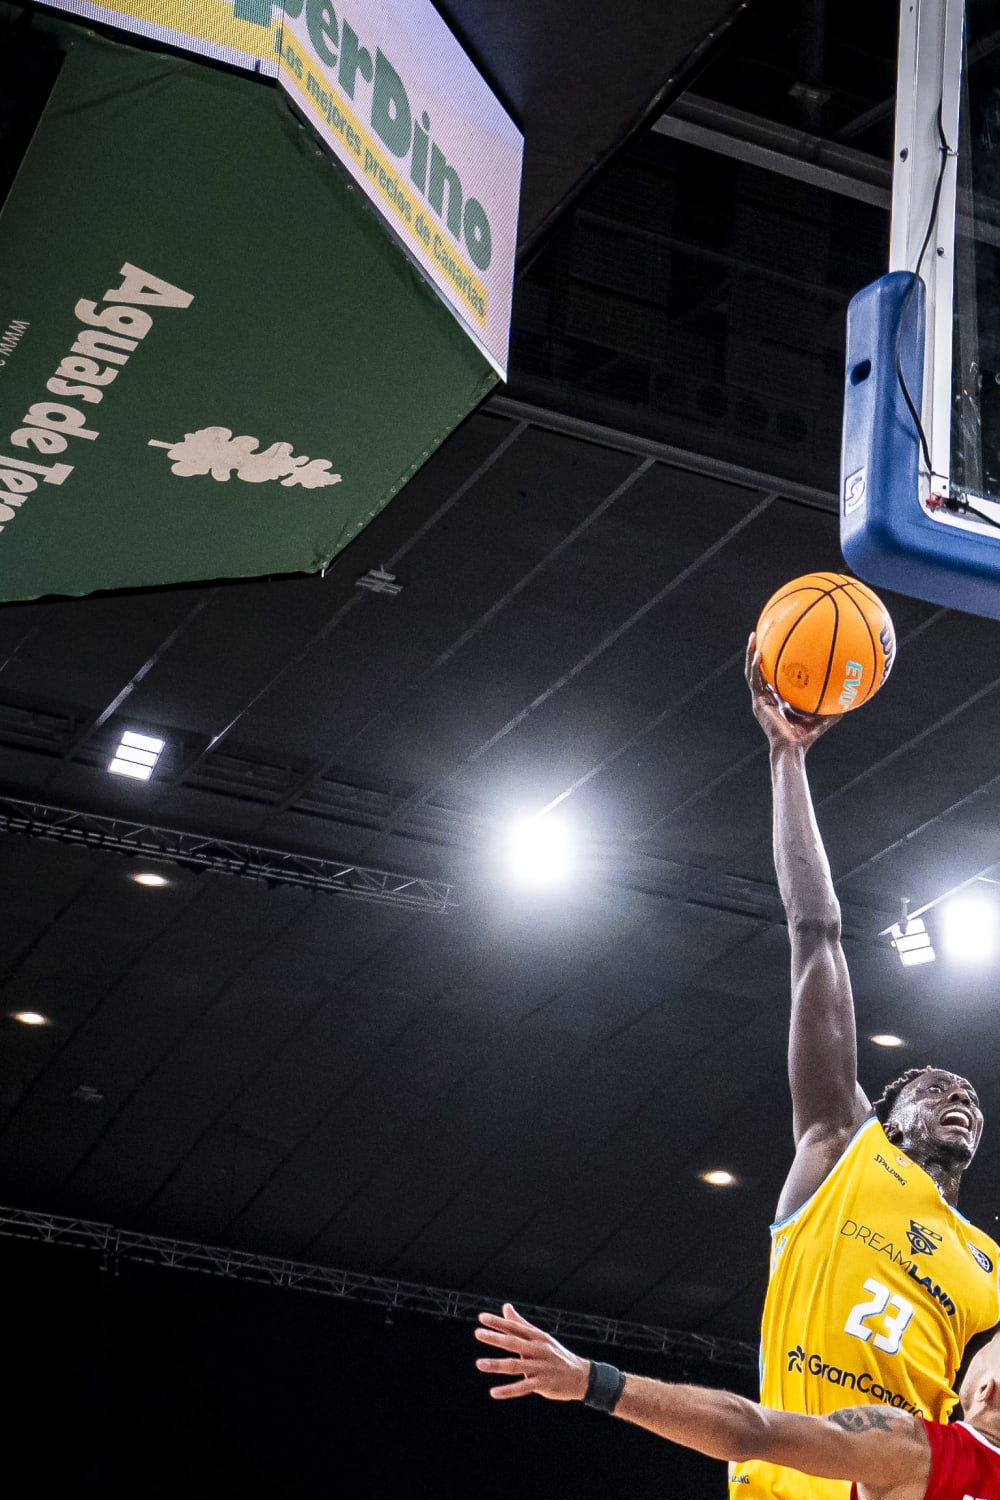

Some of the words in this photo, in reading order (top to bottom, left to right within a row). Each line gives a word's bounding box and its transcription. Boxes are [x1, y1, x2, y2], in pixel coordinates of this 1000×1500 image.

[306, 71, 361, 156] mejores
[363, 147, 412, 222] precios
[415, 213, 431, 246] de
[433, 233, 485, 317] Canarias
[45, 261, 195, 404] Aguas
[10, 402, 100, 454] de
[873, 1154, 907, 1186] SPALDING
[840, 1219, 956, 1317] DREAMLAND
[844, 1277, 914, 1356] 23
